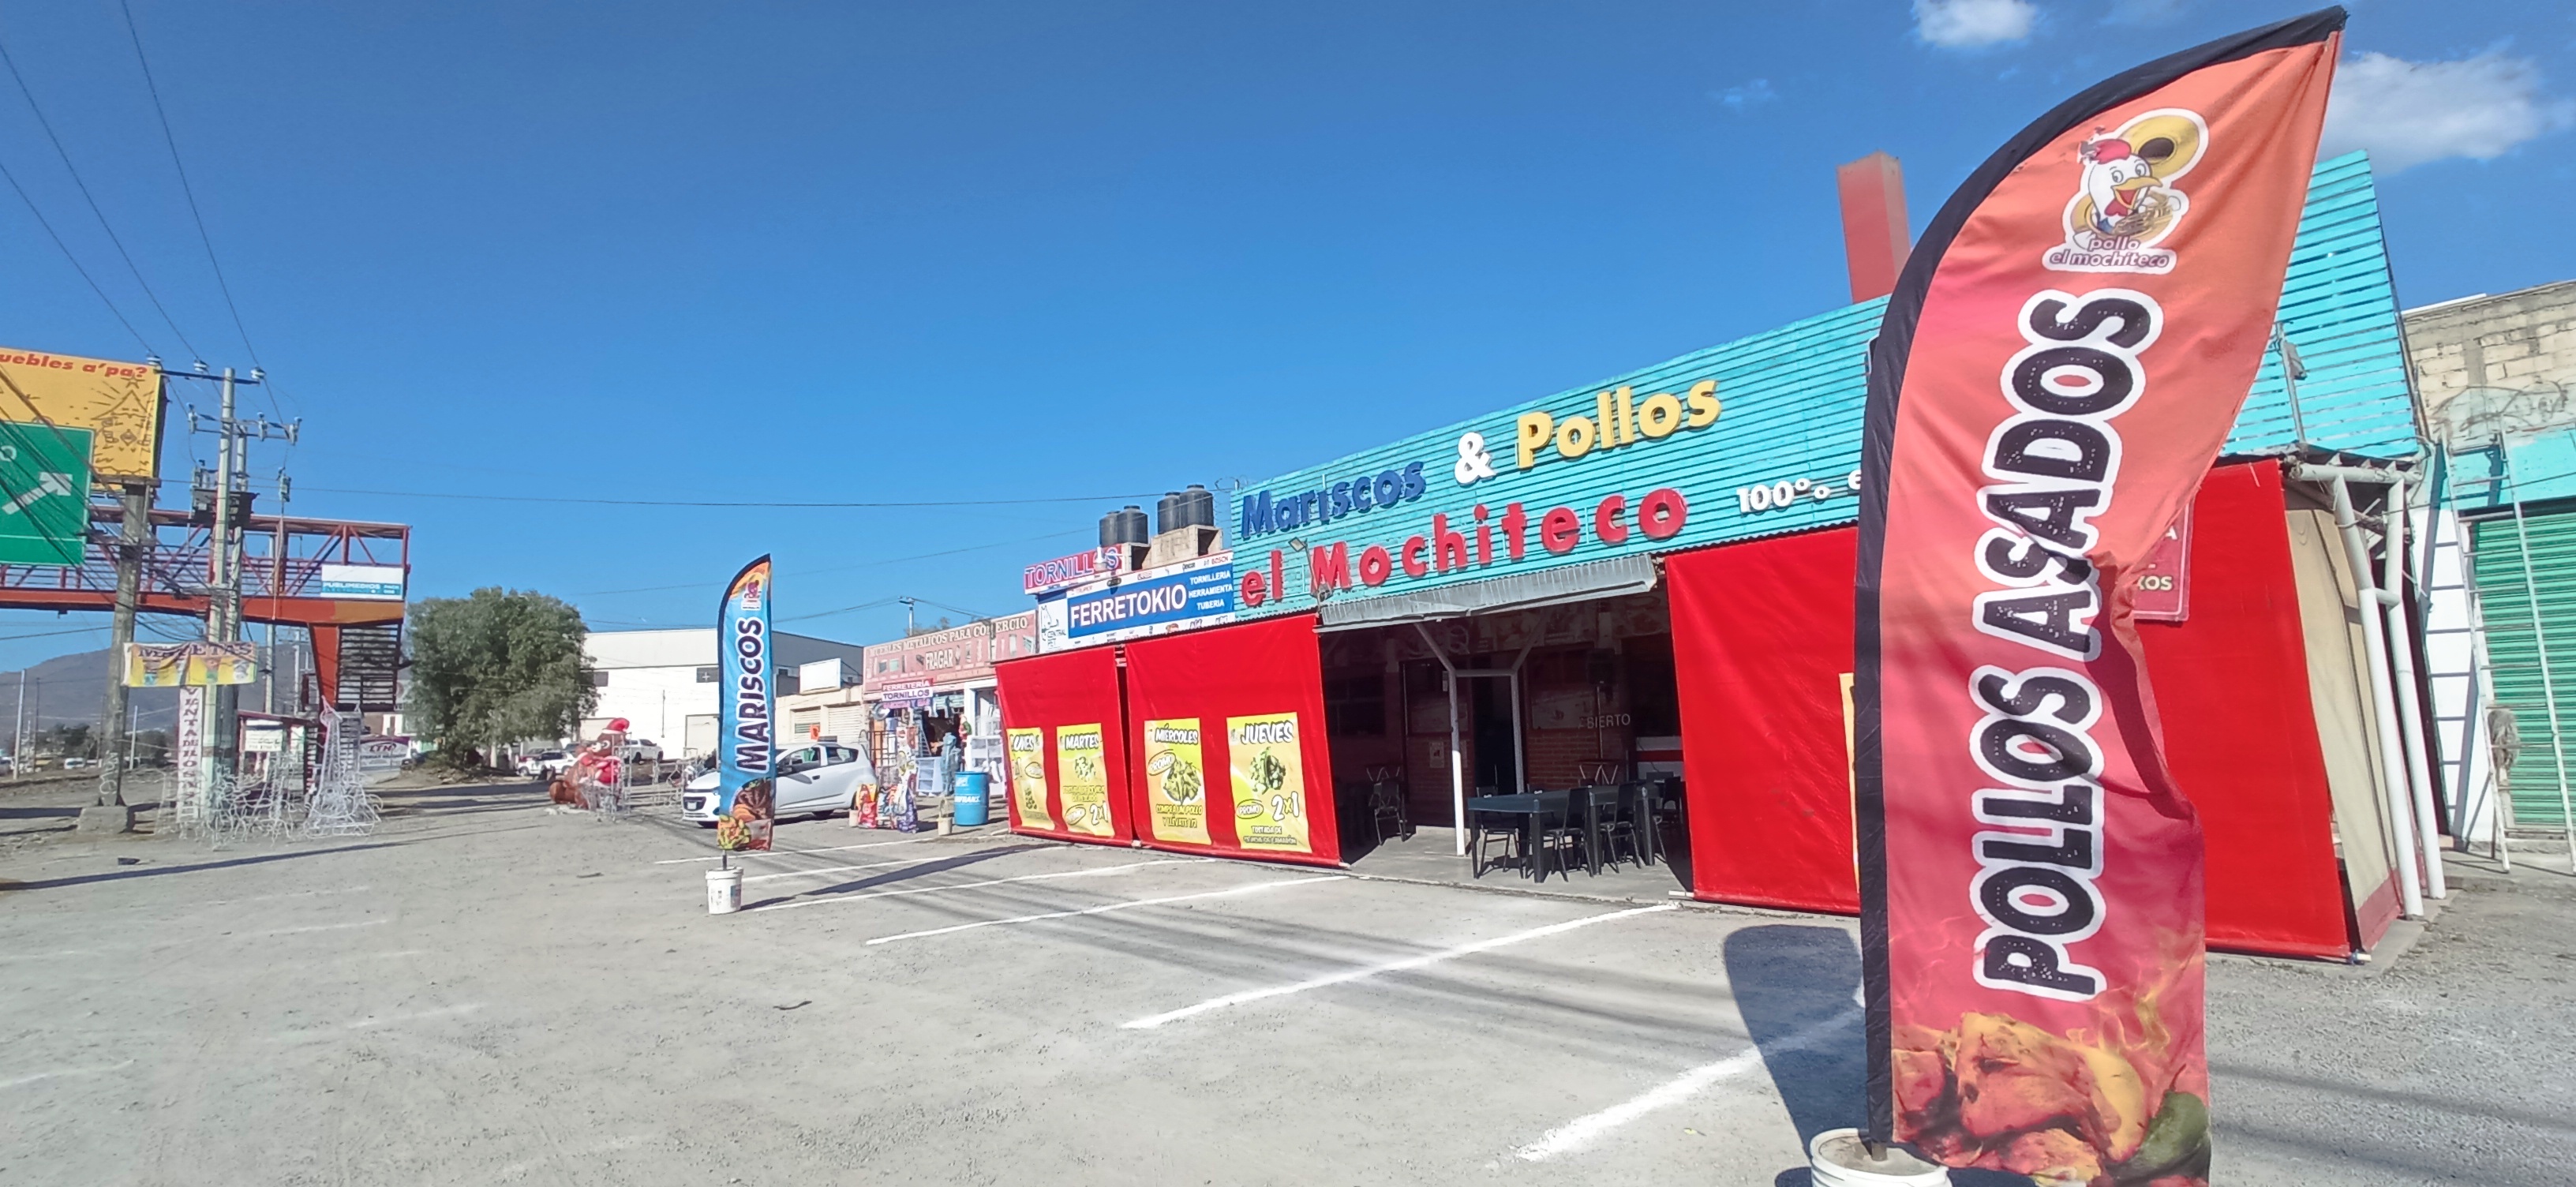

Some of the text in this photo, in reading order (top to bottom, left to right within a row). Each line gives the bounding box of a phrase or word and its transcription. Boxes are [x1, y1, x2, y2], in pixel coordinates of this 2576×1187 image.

[2087, 237, 2140, 252] pollo
[2050, 249, 2170, 268] el mochiteco
[1241, 380, 1721, 540] Mariscos & Pollos
[1240, 487, 1688, 607] el Mochiteco
[1189, 570, 1231, 585] TORNILLERIA
[1189, 584, 1233, 599] HERRAMIENTA
[1070, 584, 1187, 629] FERRETOKIO
[1196, 598, 1225, 611] TUBERIA
[949, 627, 972, 642] PARA
[1977, 298, 2152, 996] POLLOS ASADOS
[925, 647, 953, 671] FRAGAR
[736, 617, 770, 772] MARISCOS
[883, 688, 930, 701] TORNILLOS
[1065, 732, 1099, 751] MARTES
[1240, 720, 1294, 744] JUEVES
[1012, 733, 1035, 752] UNES
[1185, 805, 1203, 815] POLLO
[1238, 803, 1260, 815] PROMO
[1271, 791, 1300, 822] 2x1
